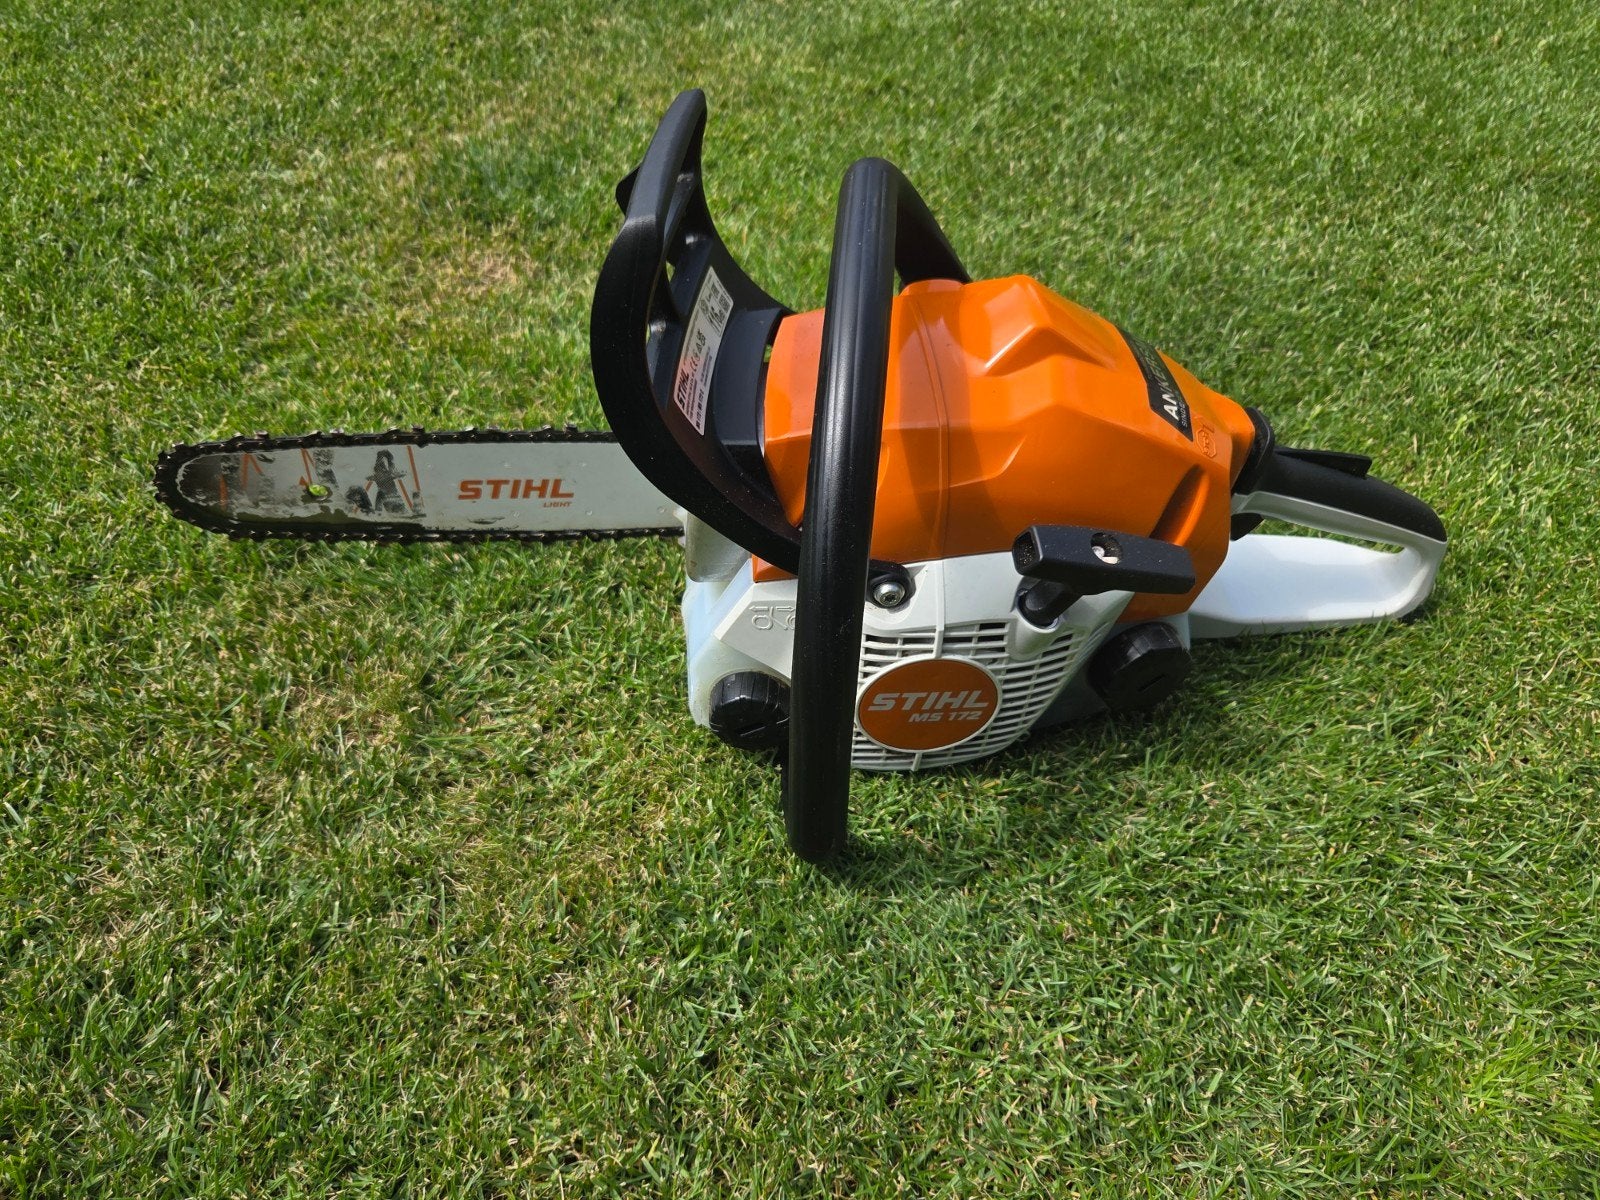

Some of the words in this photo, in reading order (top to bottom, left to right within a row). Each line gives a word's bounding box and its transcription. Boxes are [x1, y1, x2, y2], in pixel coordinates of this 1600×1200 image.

[677, 369, 689, 410] STIHL
[458, 479, 574, 500] STIHL
[868, 690, 989, 711] STIHL
[908, 712, 943, 723] MS
[948, 711, 982, 721] 172
